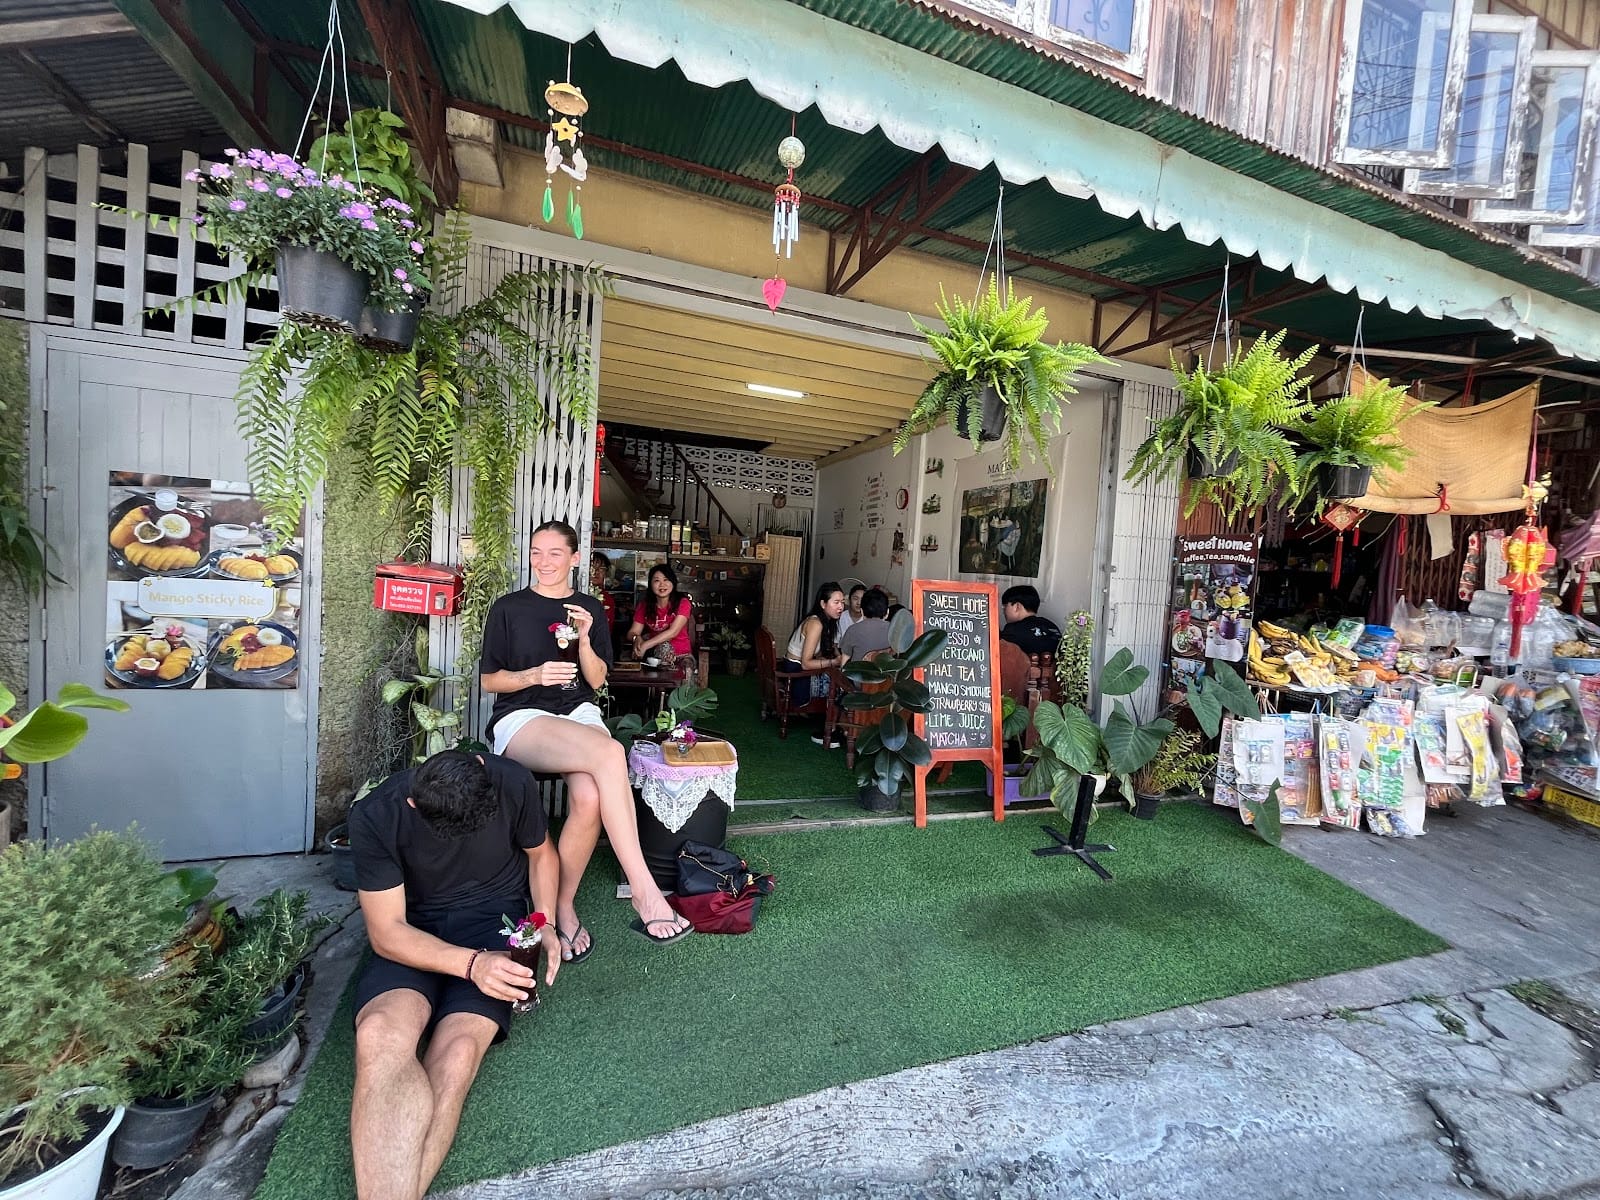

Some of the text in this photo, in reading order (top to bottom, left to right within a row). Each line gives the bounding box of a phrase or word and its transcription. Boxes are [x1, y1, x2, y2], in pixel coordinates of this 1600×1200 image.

[1183, 535, 1253, 551] Sweet Home
[149, 592, 265, 607] Mango Sticky Rice
[930, 593, 987, 613] SWEET HOME
[928, 616, 974, 632] CAPPUCINO
[947, 631, 970, 647] ESSO
[942, 646, 985, 662] ERICANO
[929, 663, 975, 681] THAI TEA
[928, 681, 959, 696] MANGO
[929, 697, 977, 712] STRAWBERRY
[928, 712, 986, 729] LIME JUICE
[930, 731, 968, 748] MATCHA
